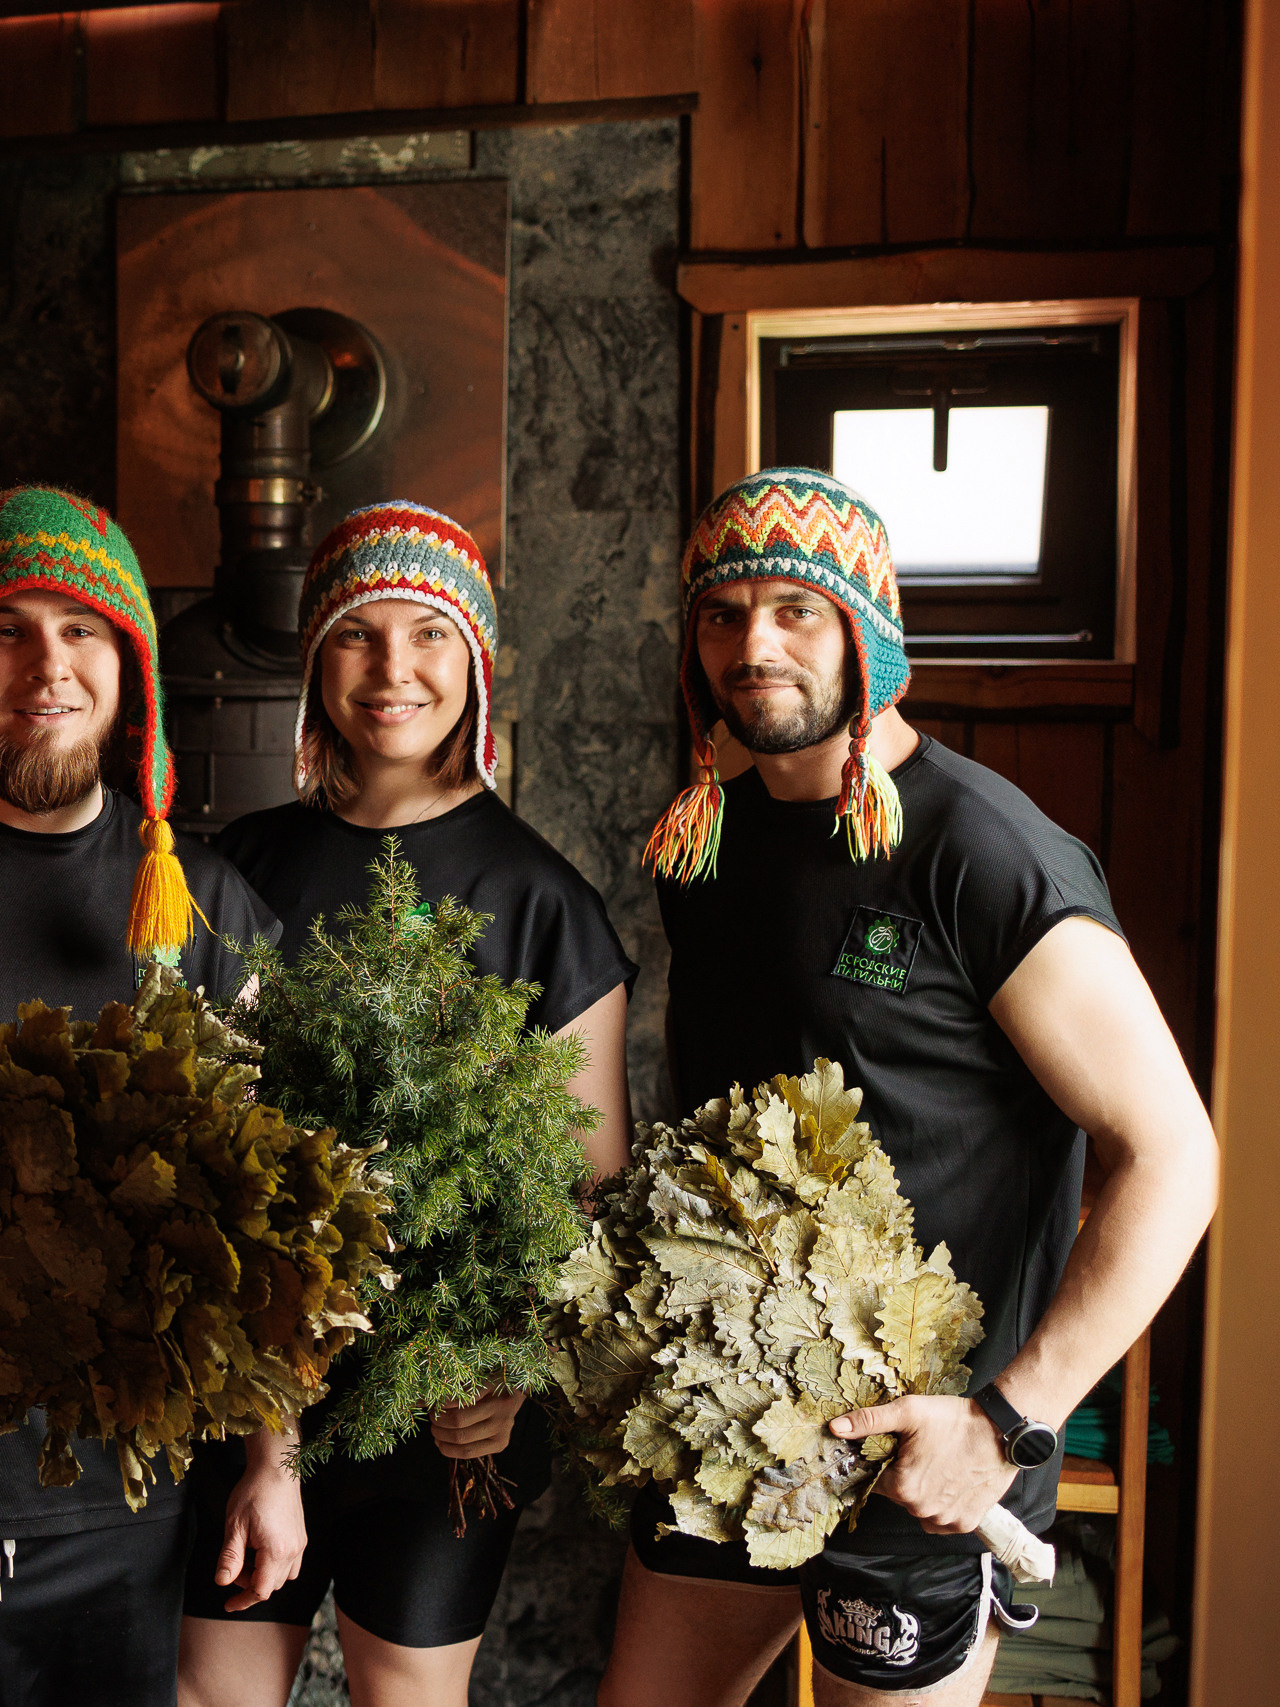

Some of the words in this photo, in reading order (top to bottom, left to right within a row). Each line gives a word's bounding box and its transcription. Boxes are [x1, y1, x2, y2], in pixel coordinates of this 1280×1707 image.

[837, 964, 904, 991] ПАРИЛЬНИ
[841, 953, 907, 980] ГОРОДСКИЕ
[833, 1610, 890, 1654] KING
[843, 1612, 877, 1628] TOP
